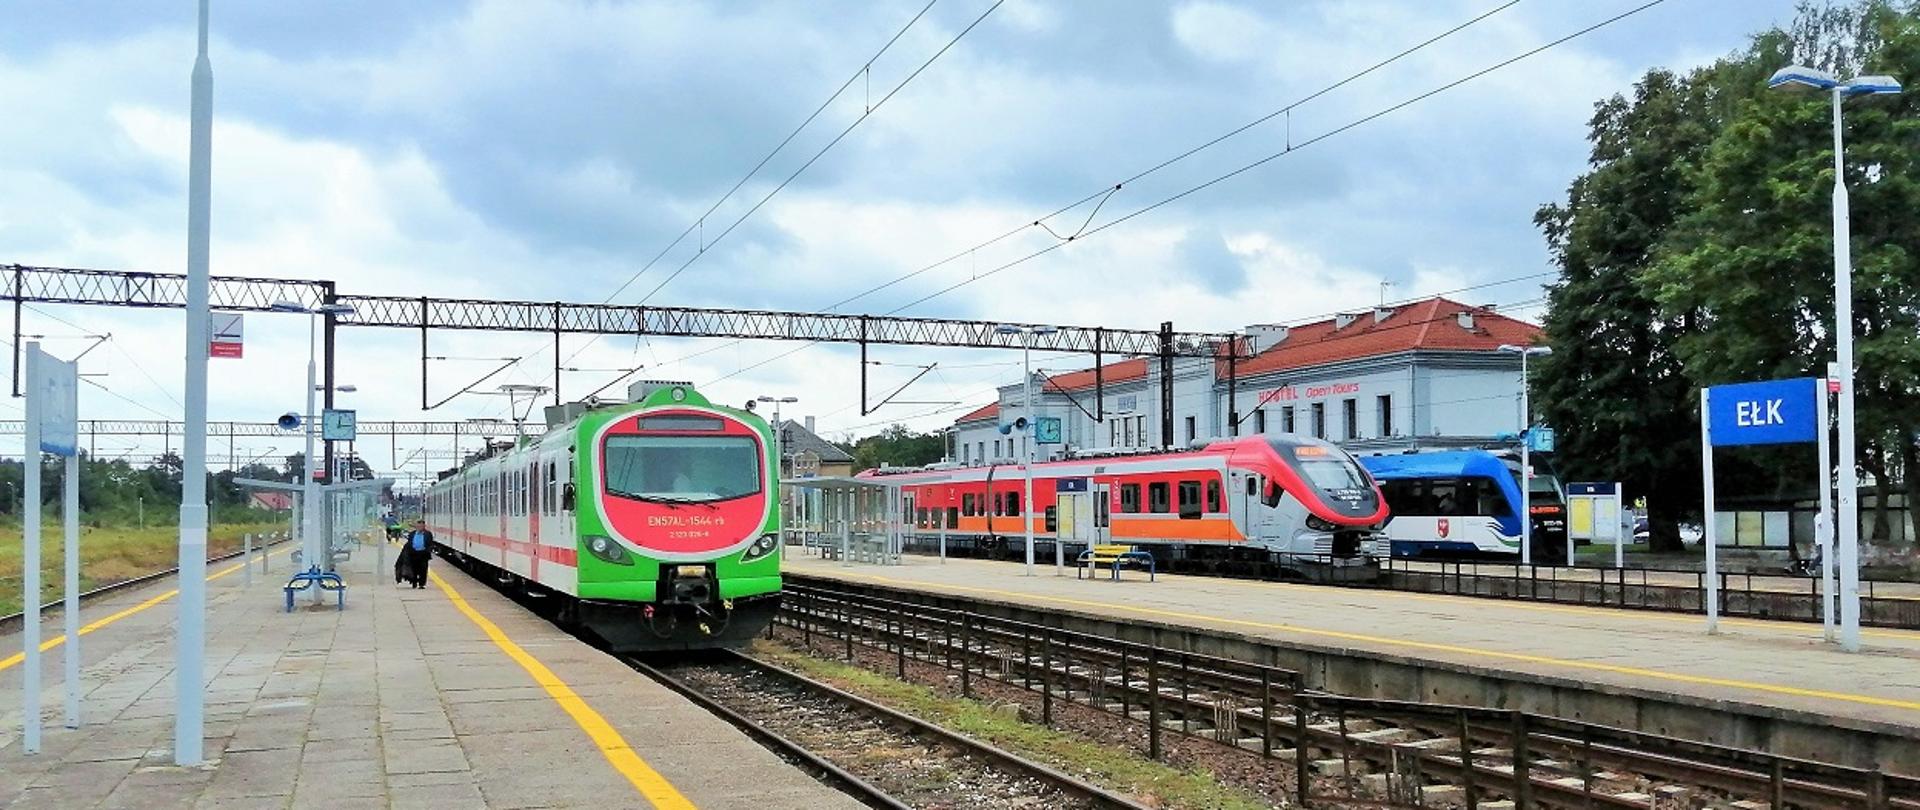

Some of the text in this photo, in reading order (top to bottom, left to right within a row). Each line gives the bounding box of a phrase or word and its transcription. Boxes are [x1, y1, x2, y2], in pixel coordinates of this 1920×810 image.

[1258, 386, 1298, 402] HOSTEL
[1736, 399, 1784, 427] EŁK
[648, 515, 712, 526] EN57AL-1544
